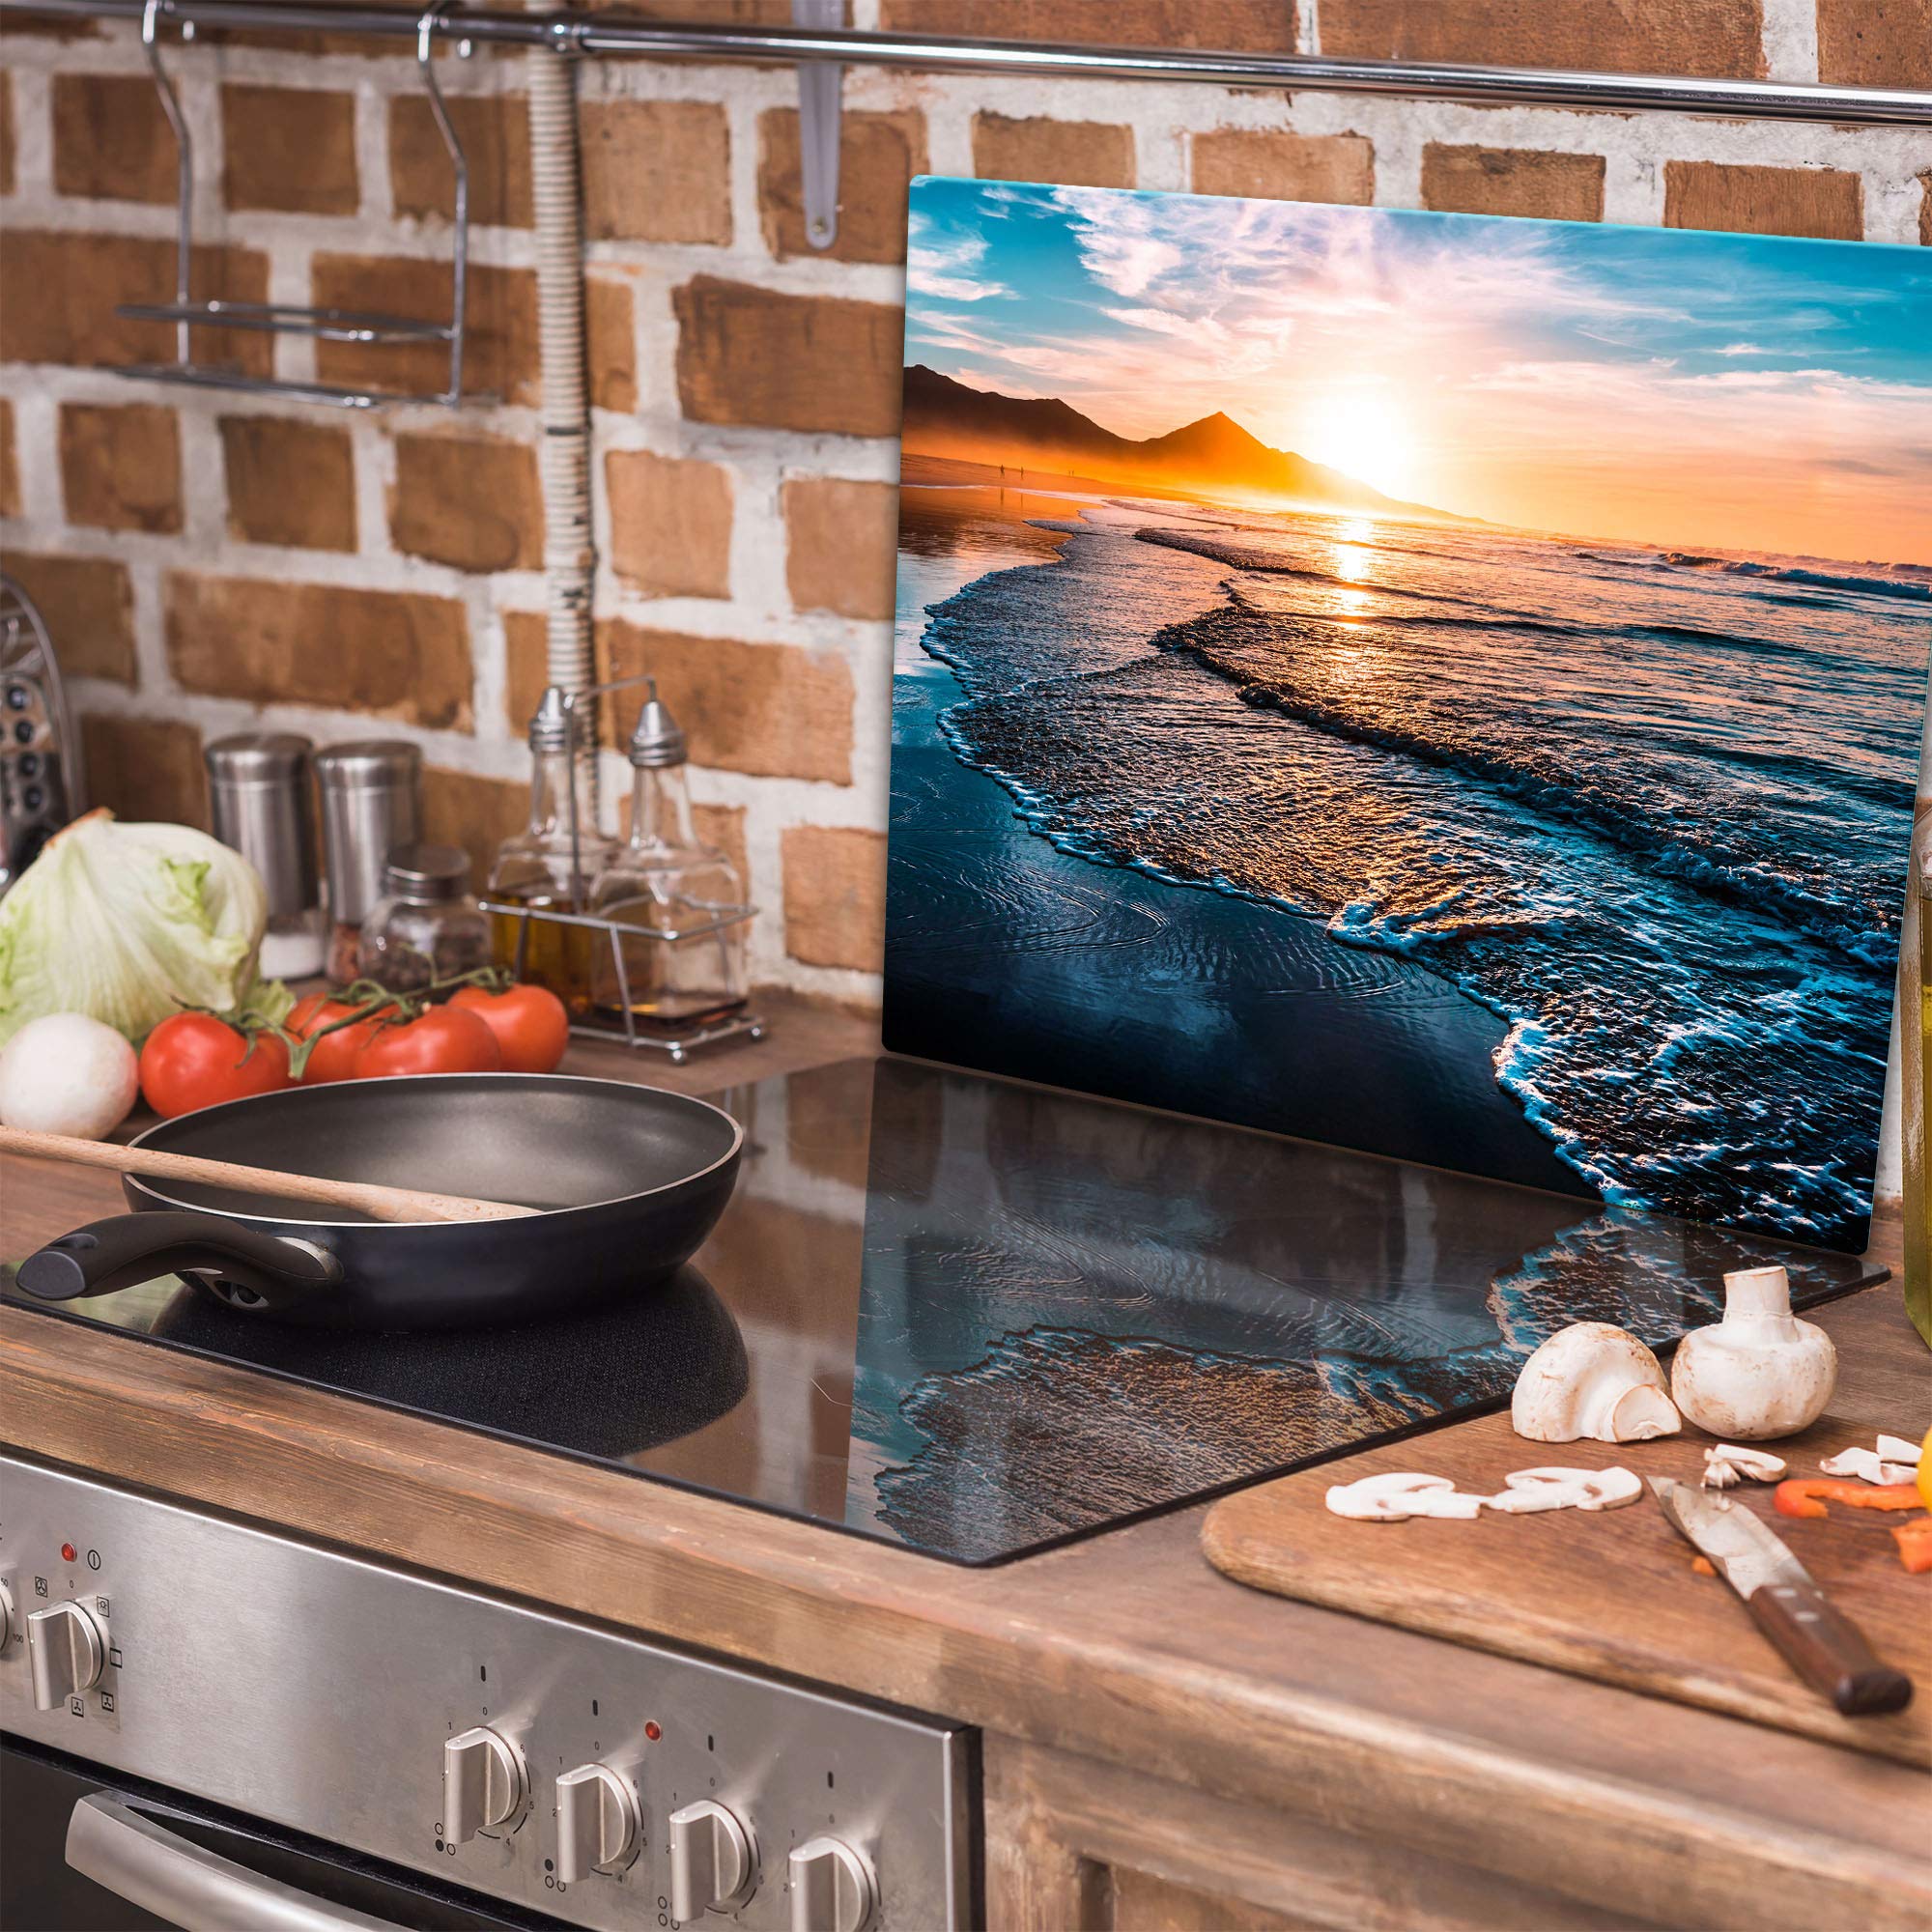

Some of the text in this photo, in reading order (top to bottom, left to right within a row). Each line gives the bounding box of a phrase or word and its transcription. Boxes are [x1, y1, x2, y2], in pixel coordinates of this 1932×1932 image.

[69, 1579, 74, 1589] 0
[482, 1706, 488, 1717] 0
[448, 1721, 453, 1731] 1
[520, 1744, 526, 1754] 6
[594, 1741, 600, 1751] 0
[558, 1756, 563, 1766] 1
[633, 1779, 639, 1789] 6
[709, 1776, 716, 1787] 0
[672, 1792, 677, 1802] 1
[529, 1801, 535, 1810] 5
[552, 1807, 557, 1818] 2
[505, 1837, 511, 1847] 4
[642, 1836, 648, 1847] 5
[665, 1844, 671, 1855] 2
[617, 1874, 623, 1884] 4
